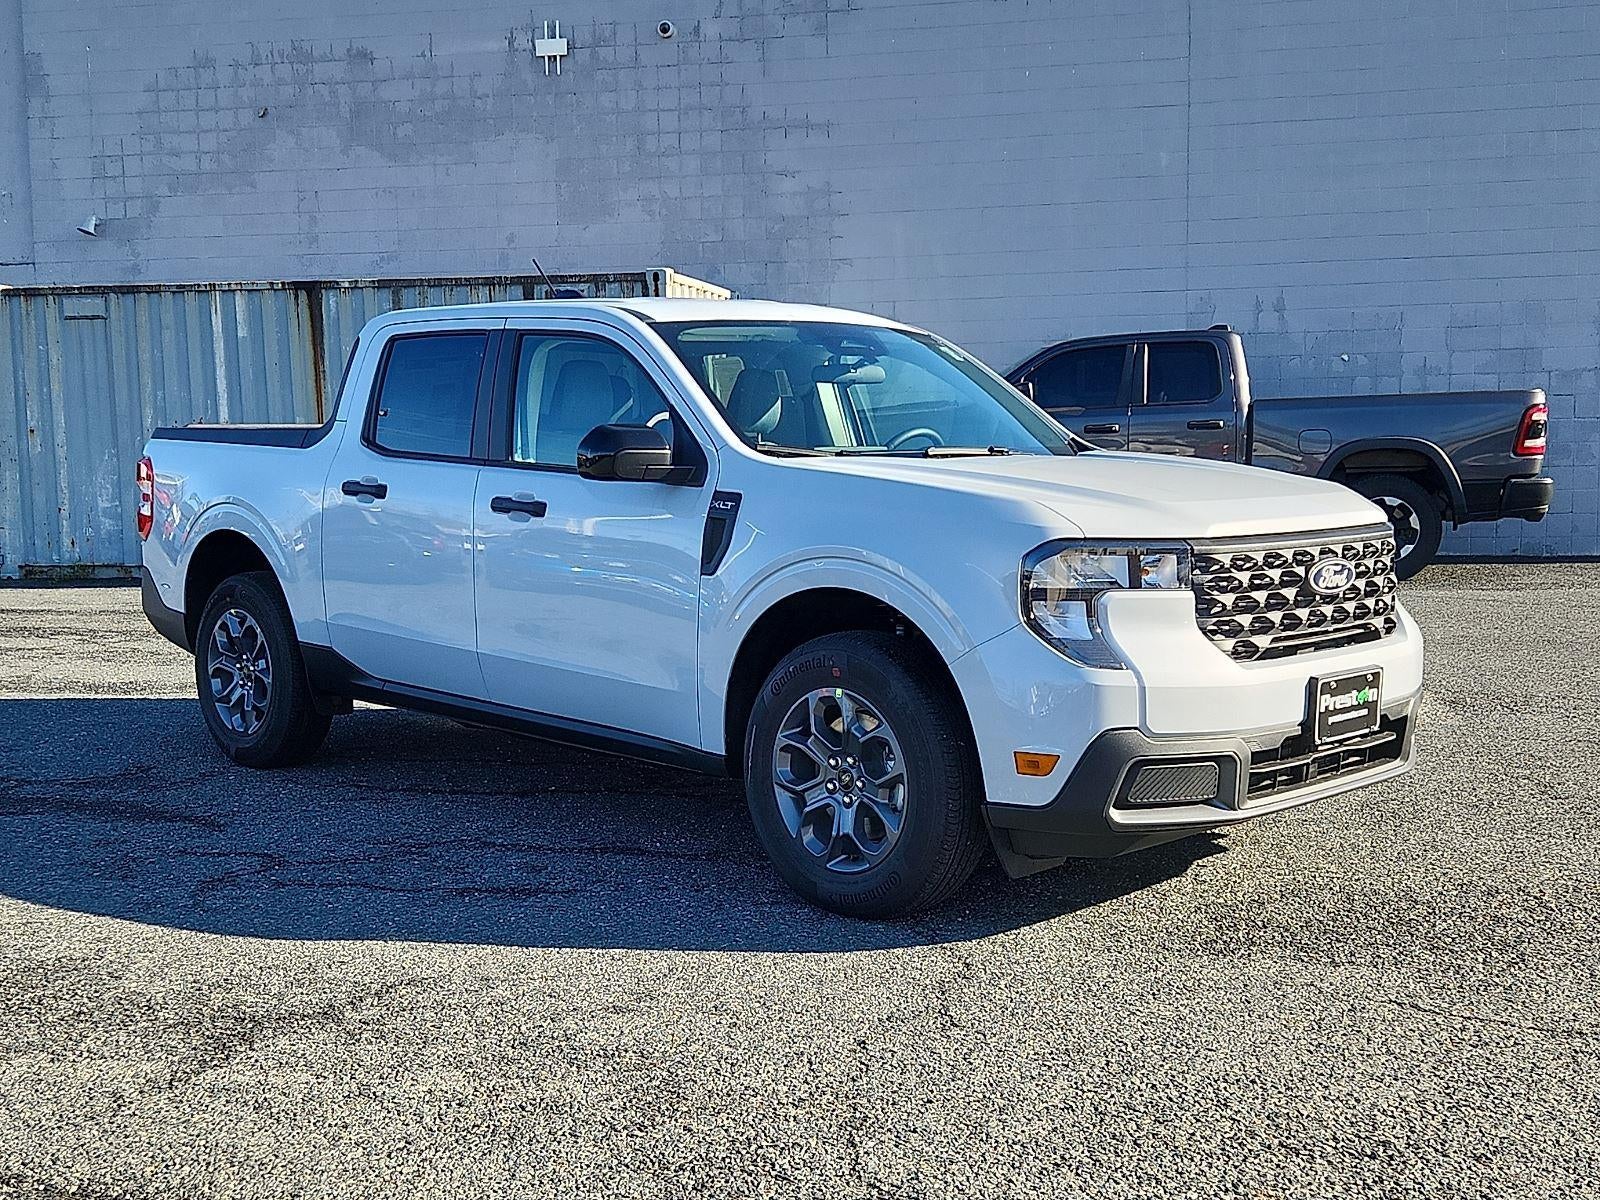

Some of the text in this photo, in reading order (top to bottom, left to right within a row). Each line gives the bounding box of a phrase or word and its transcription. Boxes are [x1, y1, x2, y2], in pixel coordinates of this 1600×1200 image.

[710, 500, 736, 510] XLT
[1318, 564, 1349, 589] Ford
[770, 653, 828, 696] Continental
